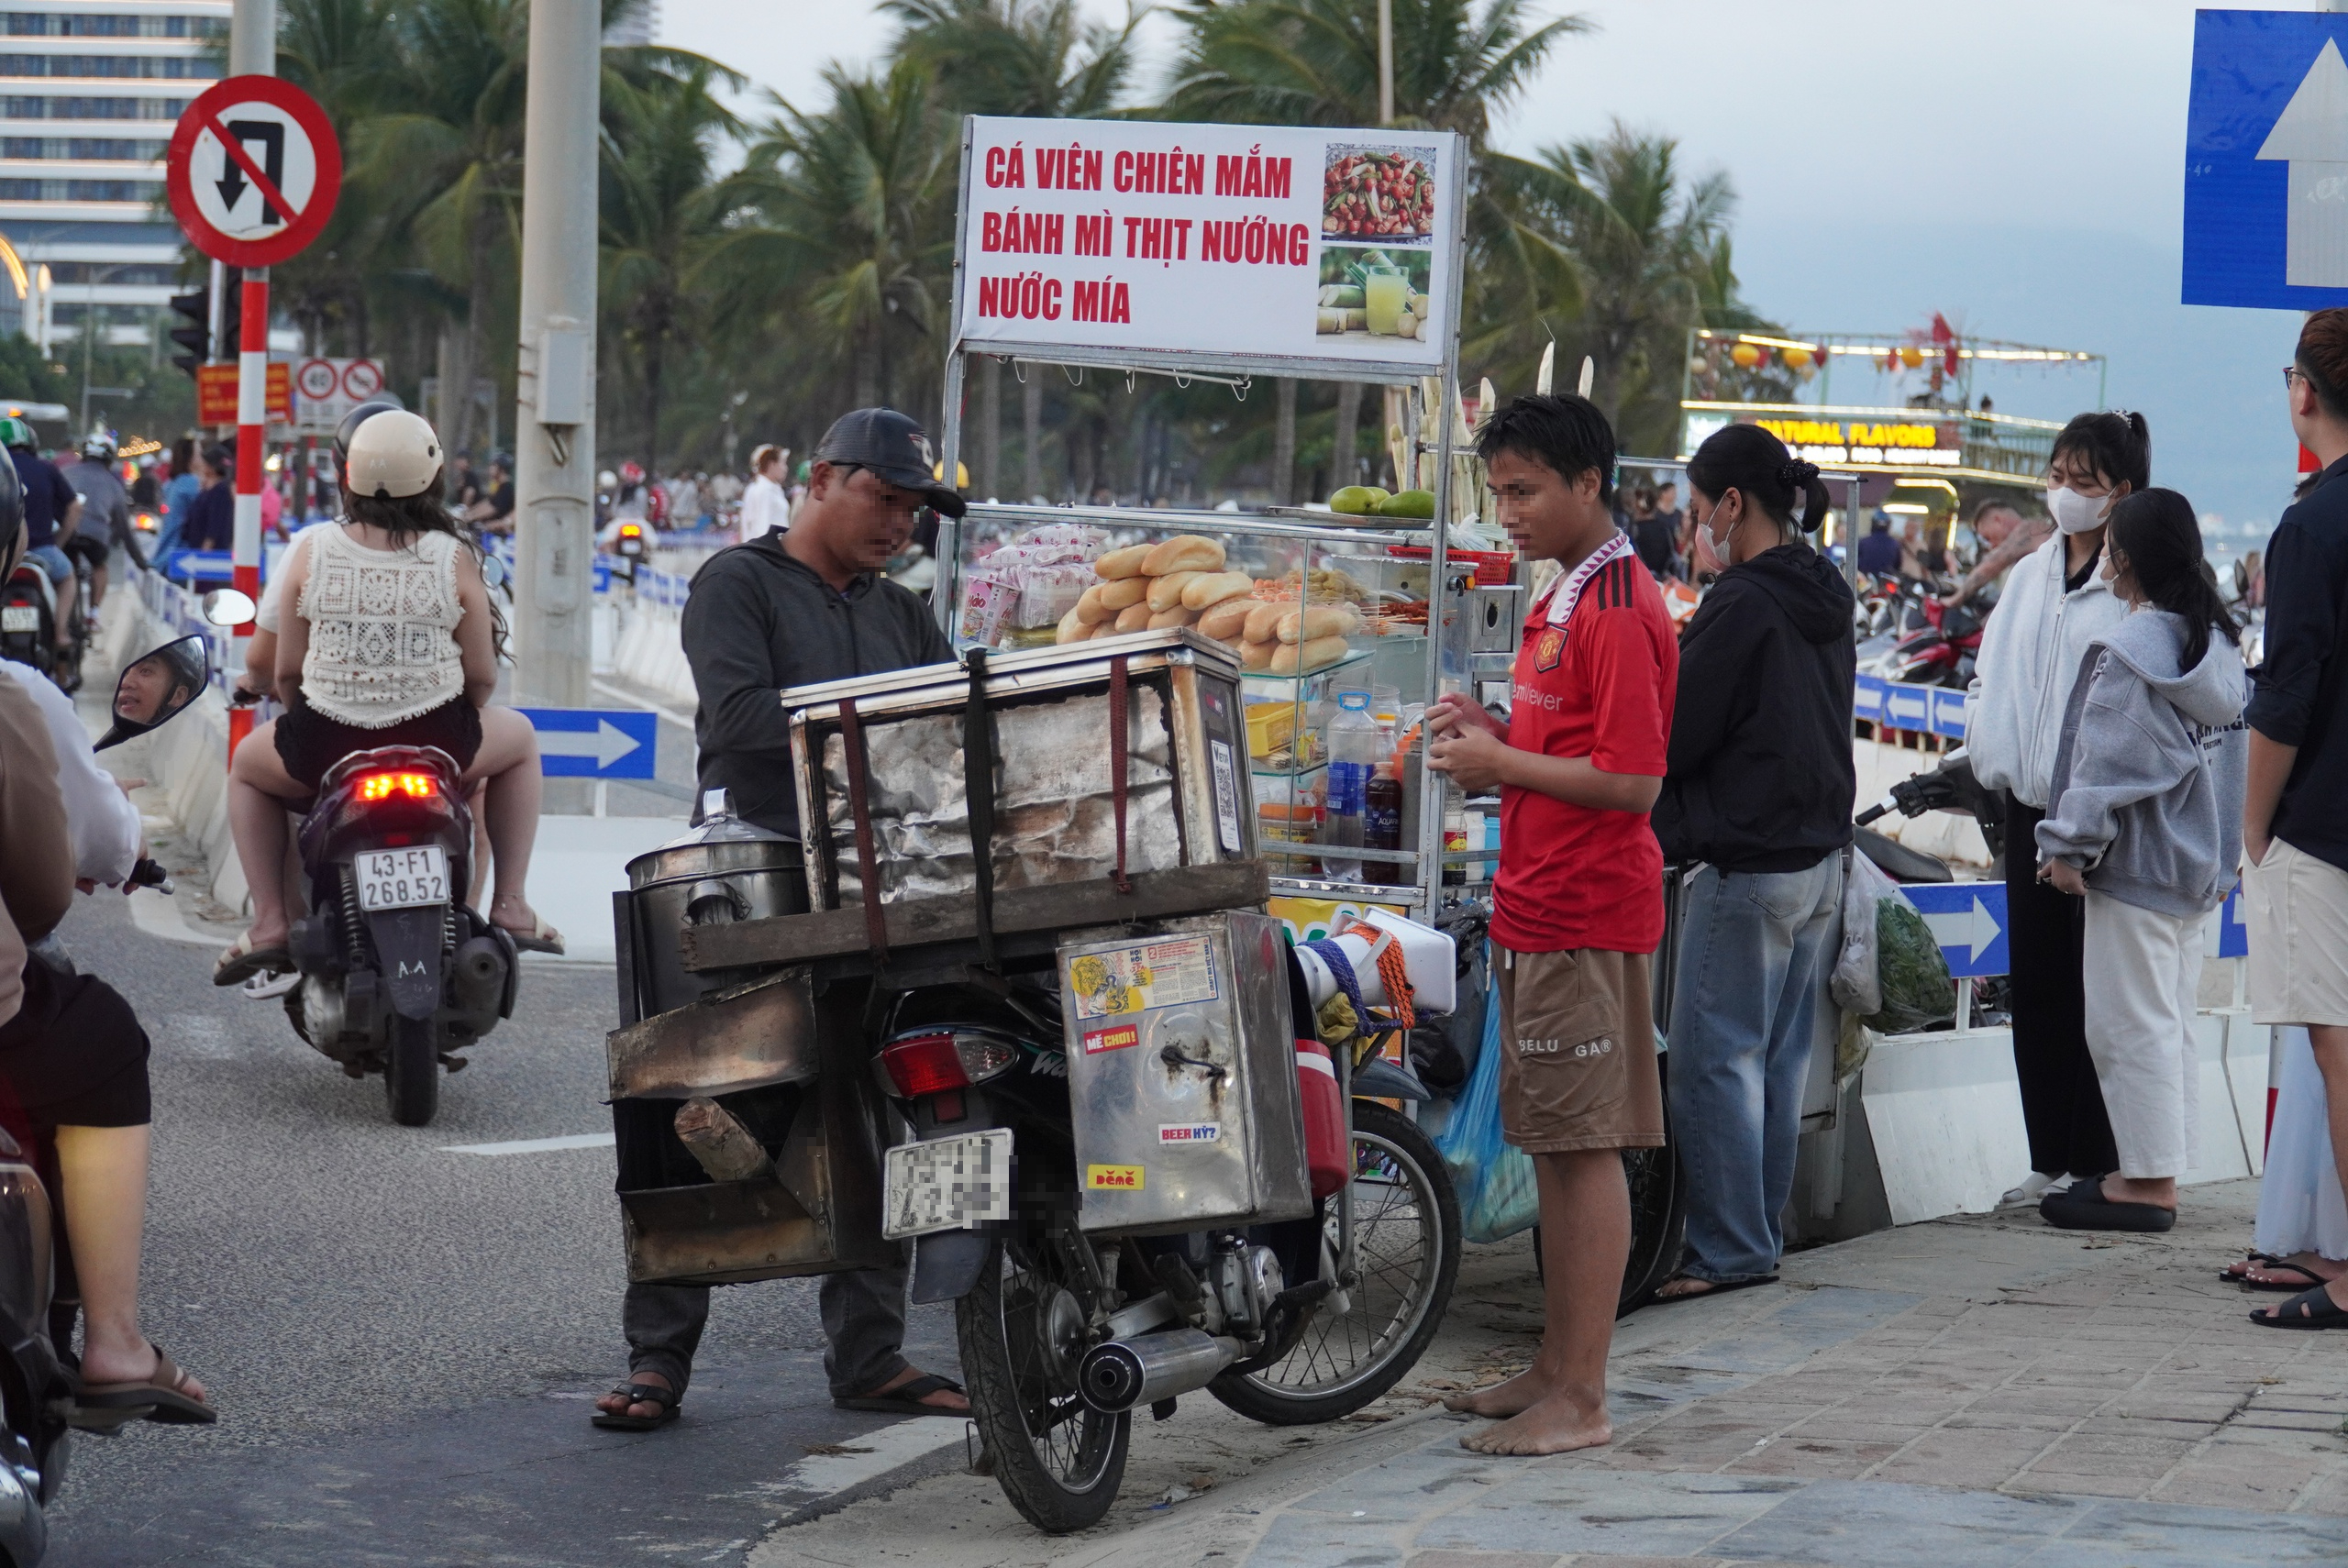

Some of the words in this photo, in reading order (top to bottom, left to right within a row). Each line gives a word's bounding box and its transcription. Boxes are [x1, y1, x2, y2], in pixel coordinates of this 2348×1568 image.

[985, 141, 1025, 189] CÁ
[1036, 141, 1103, 191] VIÊN
[1113, 145, 1204, 195] CHIÊN
[1215, 143, 1291, 199] MẮM
[981, 206, 1065, 255] BÁNH
[1075, 208, 1112, 257] MÌ
[1124, 216, 1192, 268] THỊT
[1202, 215, 1309, 266] NƯỚNG
[979, 271, 1062, 321] NƯỚC
[1072, 275, 1131, 324] MÍA
[1755, 419, 1844, 446] NATURAL
[1848, 422, 1937, 447] FLAVORS
[371, 850, 431, 878] 43-F1
[366, 877, 444, 906] 268.52
[1518, 1039, 1558, 1052] BELU
[1162, 1129, 1191, 1140] BEER
